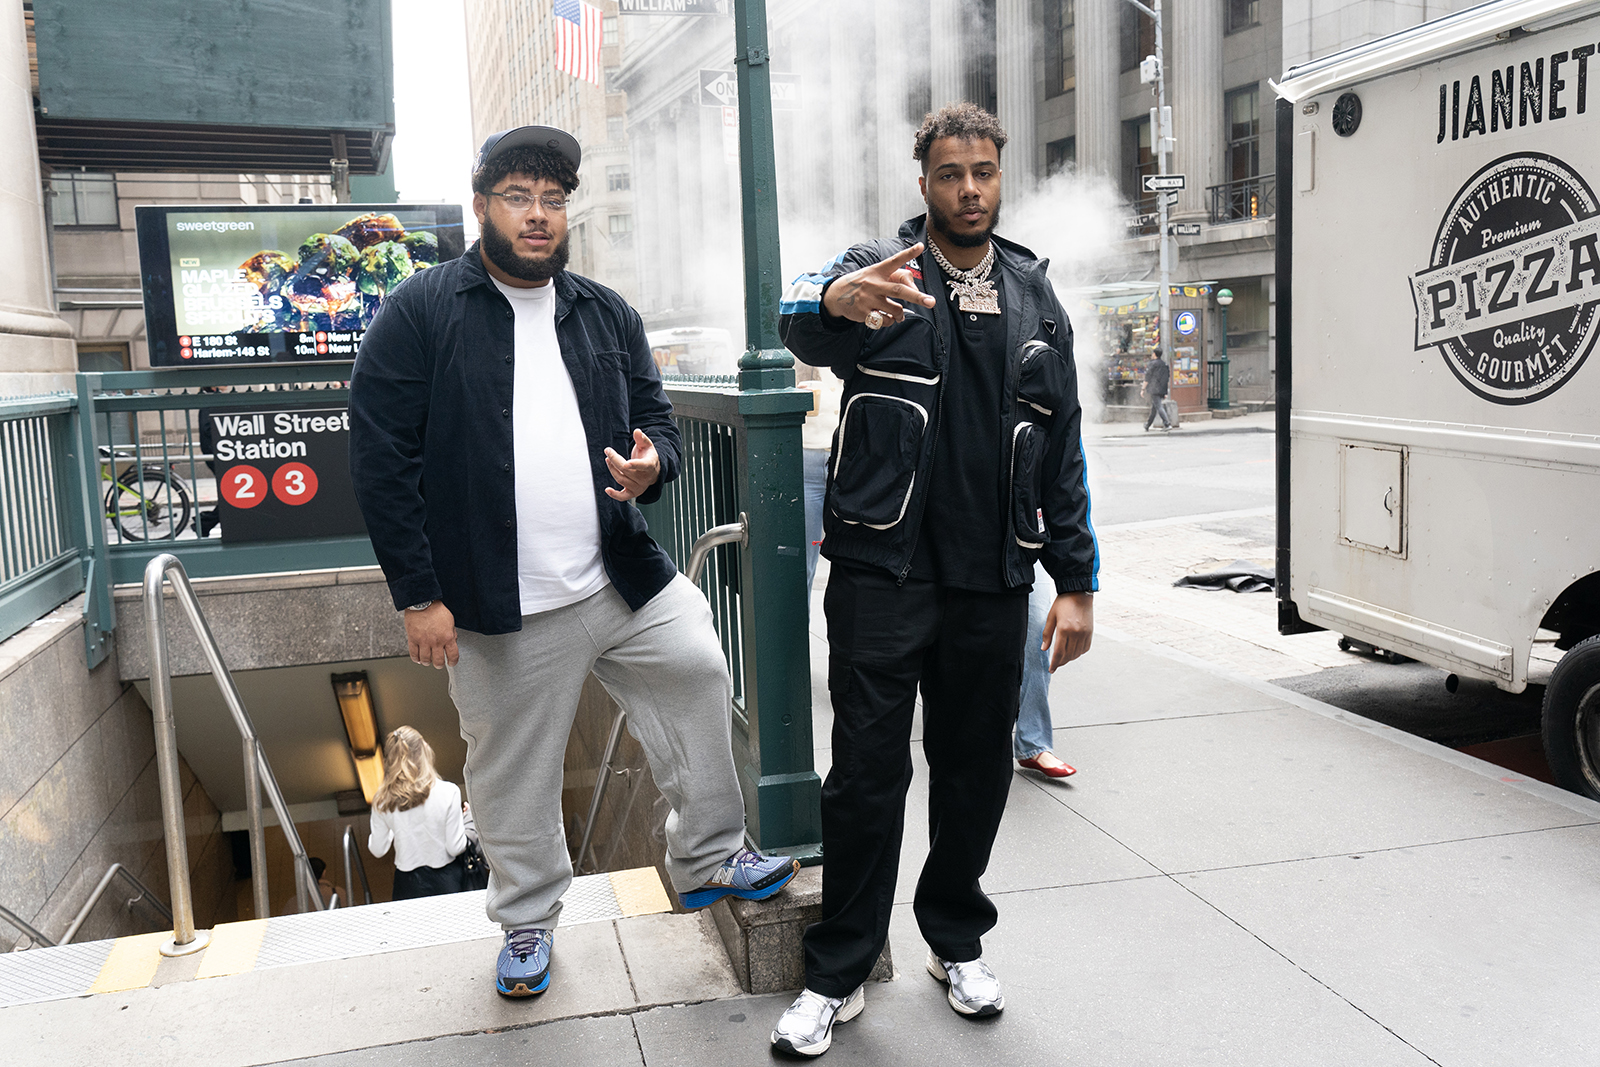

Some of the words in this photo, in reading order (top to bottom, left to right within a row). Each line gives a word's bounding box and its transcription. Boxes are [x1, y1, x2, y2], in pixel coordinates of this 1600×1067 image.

[621, 0, 686, 11] WILLIAM
[716, 81, 737, 97] ON
[771, 84, 788, 99] AY
[1437, 42, 1600, 144] JIANNET
[1457, 174, 1556, 235] AUTHENTIC
[176, 221, 254, 233] sweetgreen
[1178, 226, 1197, 234] WILLIAM
[1481, 217, 1542, 248] Premium
[181, 269, 248, 284] MAPLE
[1427, 232, 1600, 330] PIZZA
[182, 282, 259, 297] GLAZED
[184, 293, 284, 312] BRUSSELS
[185, 309, 276, 325] SPROUTS
[191, 336, 201, 347] E
[203, 336, 223, 347] 180
[224, 335, 238, 346] St
[327, 332, 351, 342] New
[1493, 321, 1547, 348] Quality
[193, 346, 256, 358] Harlem-148
[256, 345, 270, 357] St
[294, 344, 315, 355] 10m
[328, 343, 352, 354] New
[1477, 333, 1568, 383] GOURMET
[214, 414, 265, 437] Wall
[274, 411, 350, 435] Street
[216, 438, 307, 461] Station
[234, 473, 256, 499] 2
[285, 470, 306, 496] 3
[712, 867, 736, 886] N
